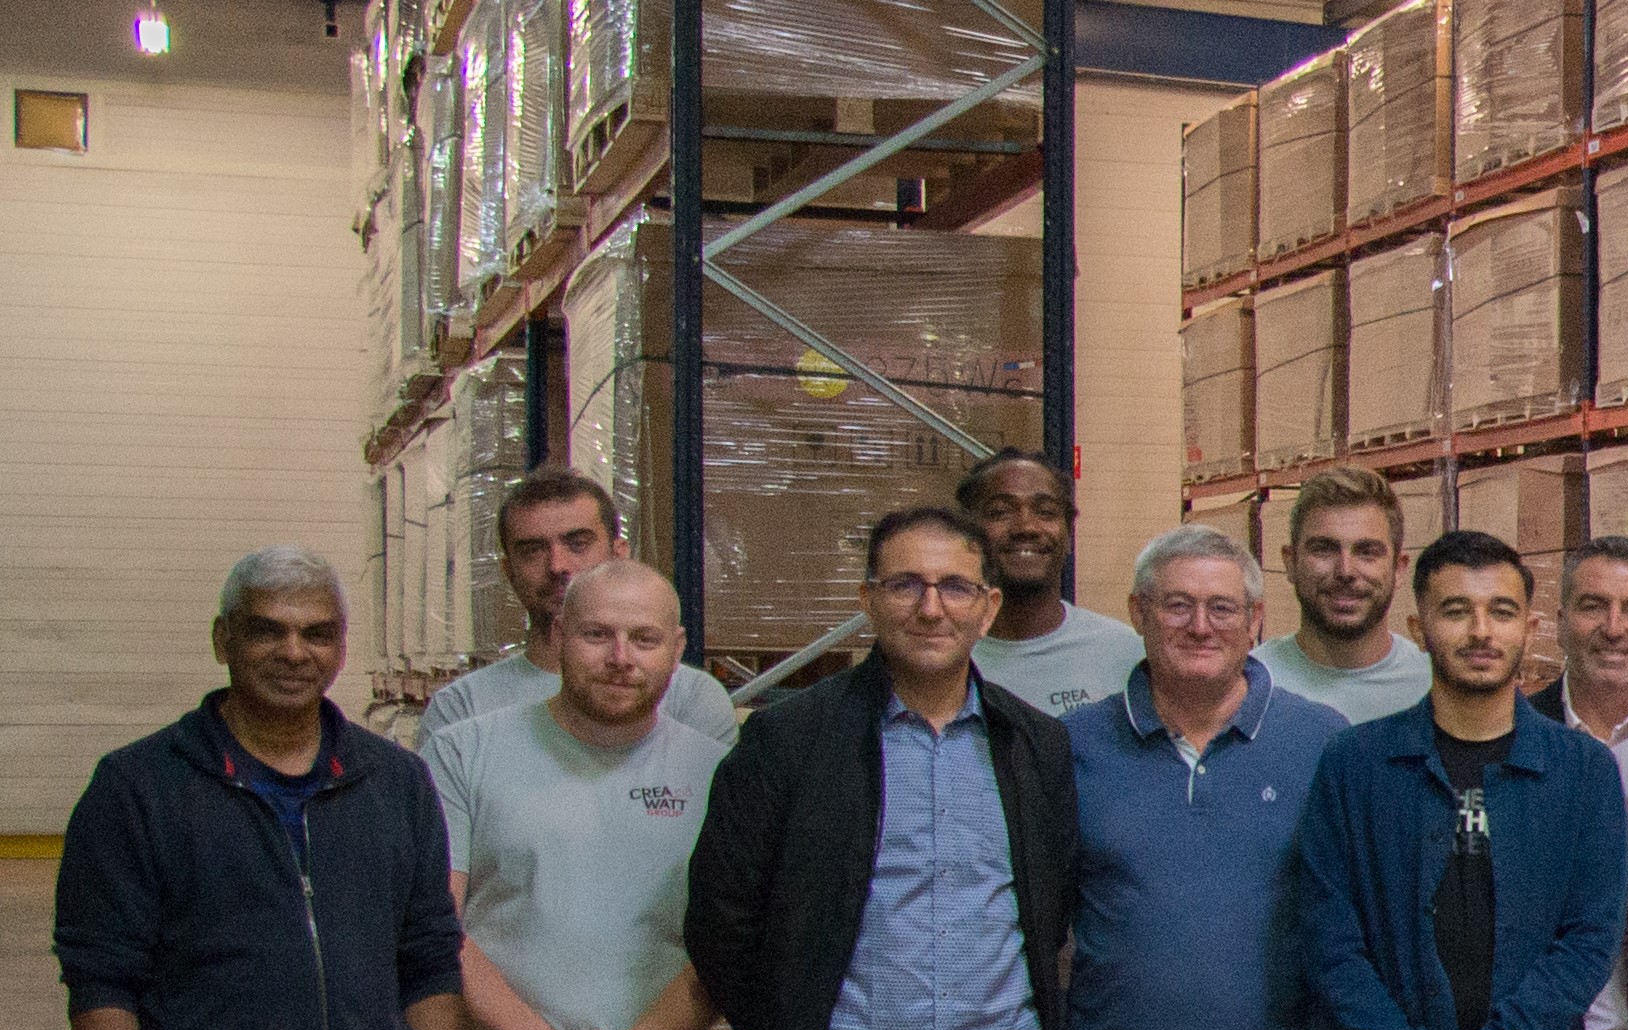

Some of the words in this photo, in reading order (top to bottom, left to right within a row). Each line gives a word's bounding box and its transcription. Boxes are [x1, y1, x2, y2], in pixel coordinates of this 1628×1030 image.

[1050, 689, 1091, 705] CREA
[629, 785, 673, 800] CREA
[643, 798, 688, 811] WATT
